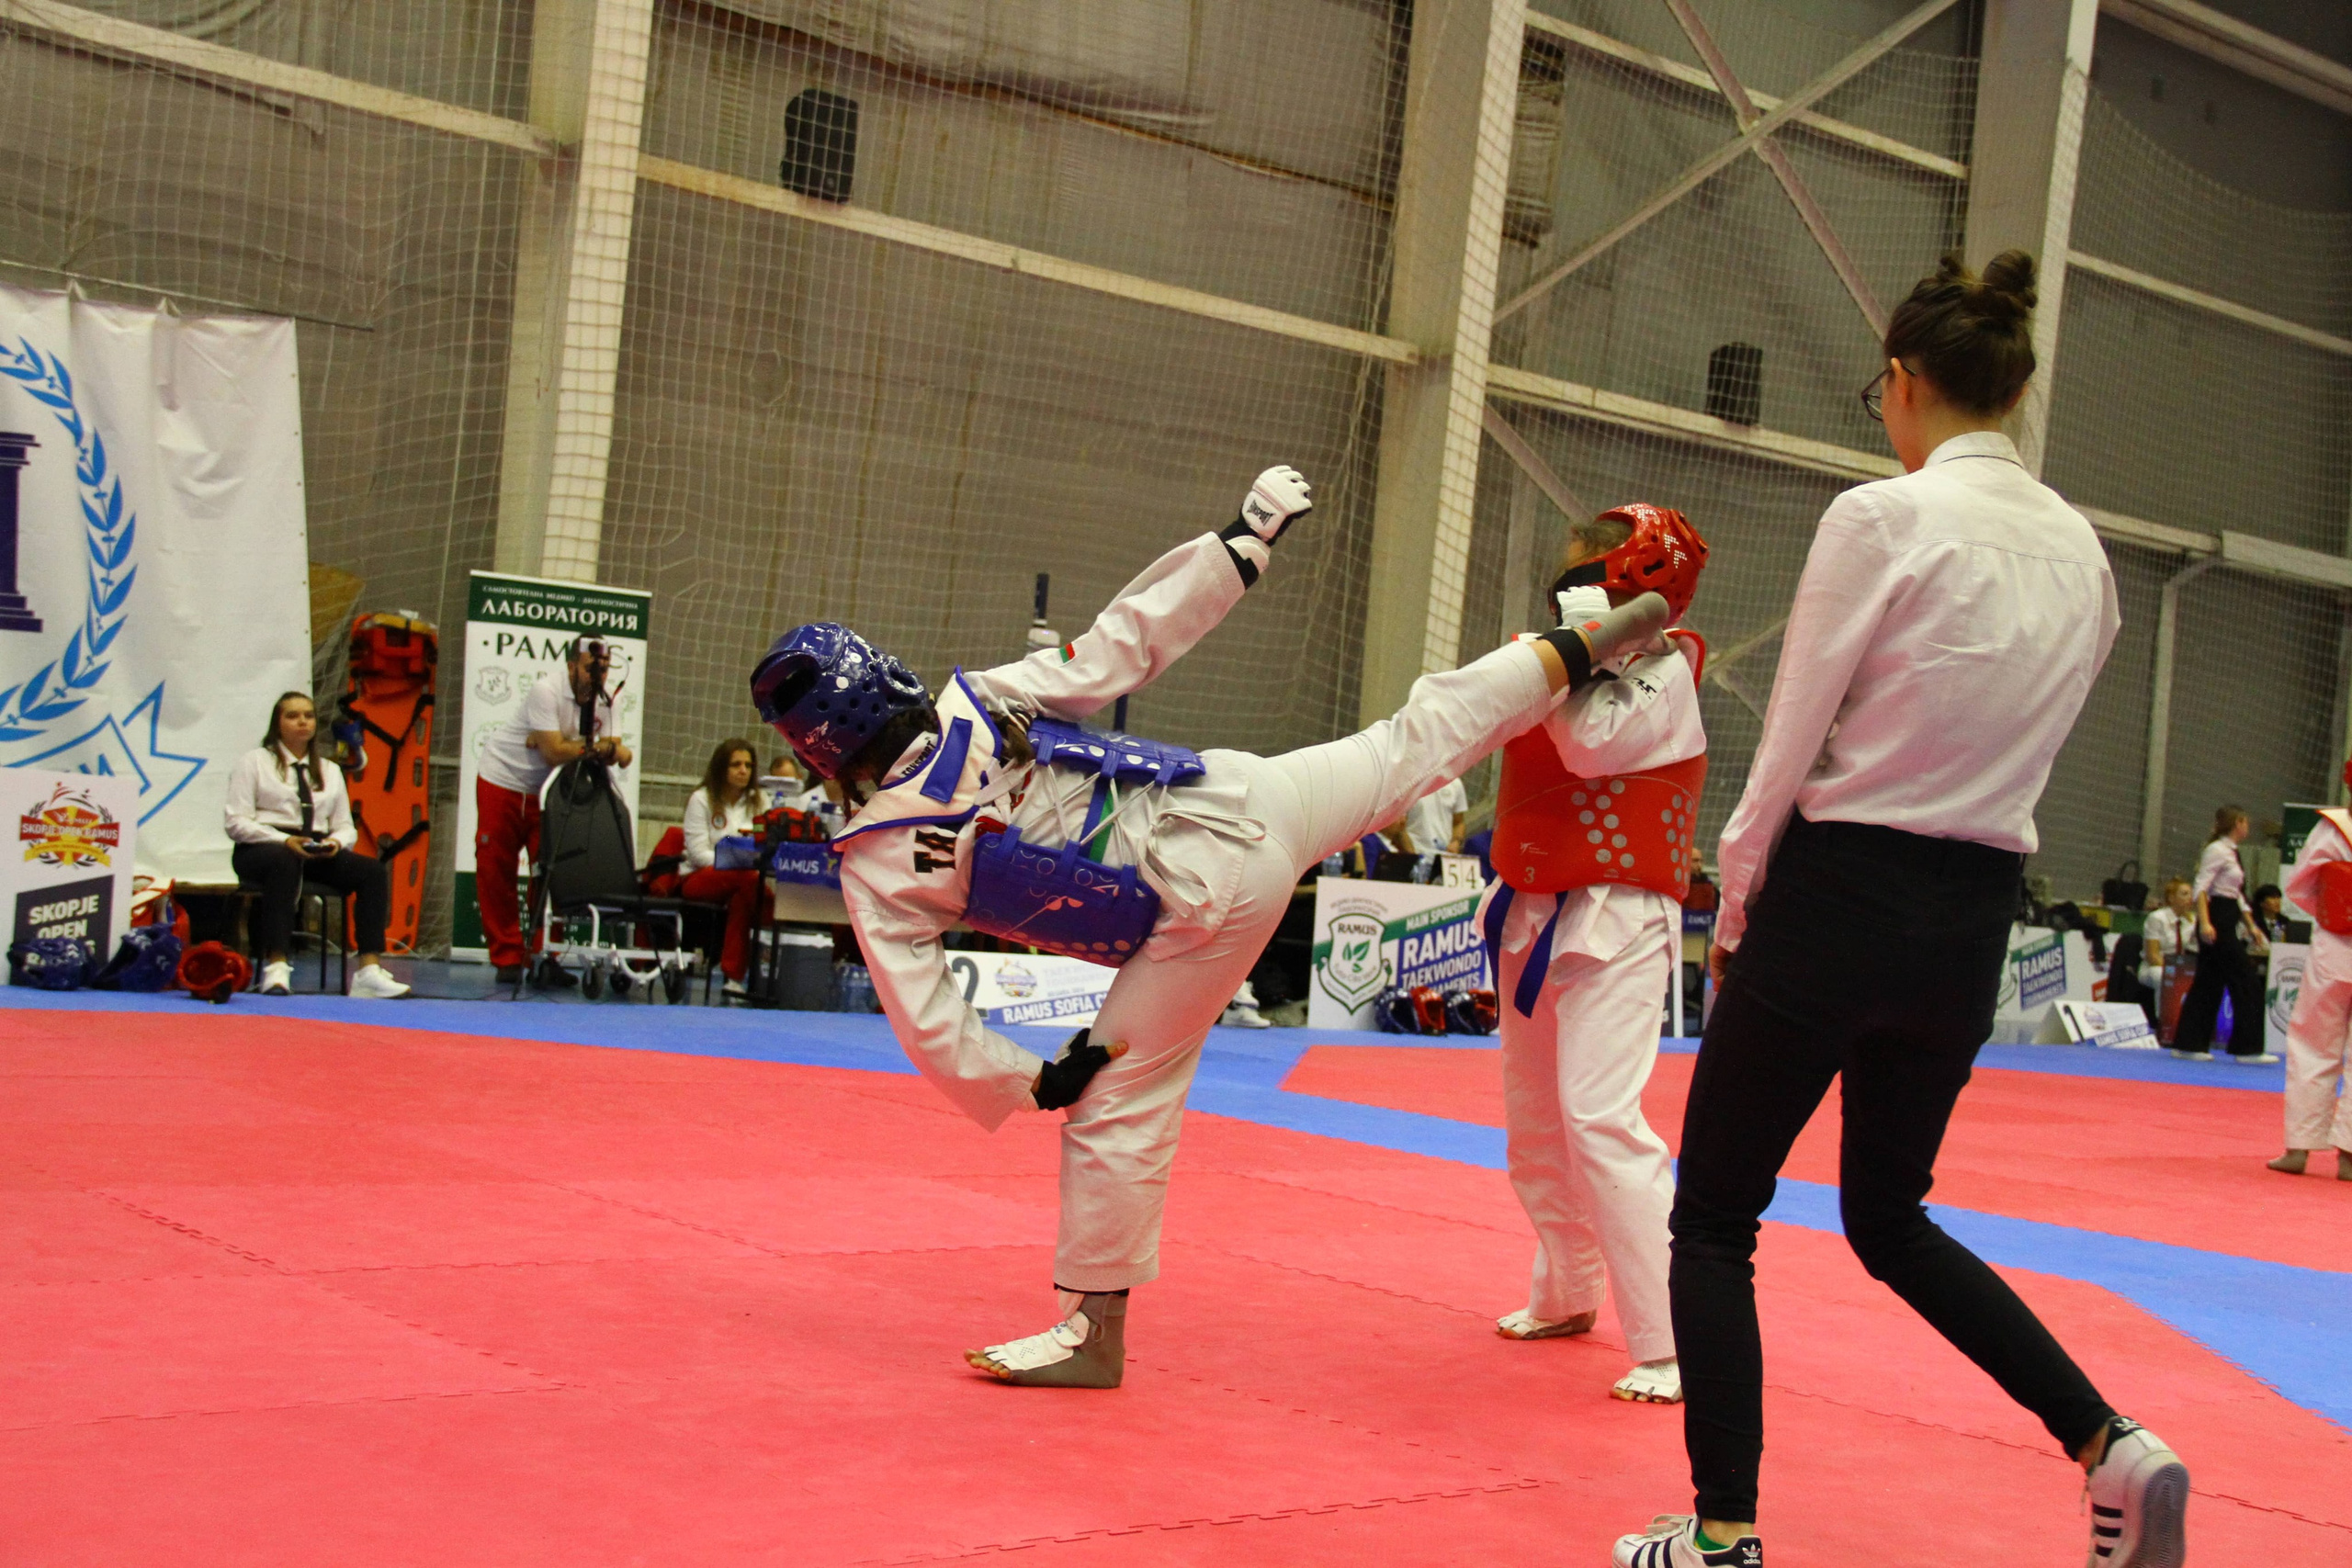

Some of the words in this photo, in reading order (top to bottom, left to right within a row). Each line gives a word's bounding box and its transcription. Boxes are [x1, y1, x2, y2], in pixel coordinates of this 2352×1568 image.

[481, 598, 639, 631] ЛАБОРАТОРИЯ
[496, 632, 624, 670] РАМС
[22, 823, 58, 835] SKOPJE
[59, 826, 84, 837] OPEN
[85, 828, 119, 840] RAMUS
[1523, 866, 1535, 885] 3
[28, 894, 100, 925] SKOPJE
[1406, 912, 1430, 931] MAIN
[1338, 922, 1376, 935] RAMUS
[1402, 919, 1483, 970] RAMUS
[1401, 949, 1482, 992] TAEKWONDO
[2021, 946, 2063, 981] RAMUS
[952, 955, 989, 1018] 2
[1002, 1000, 1053, 1024] RAMUS
[1053, 996, 1095, 1016] SOFIA
